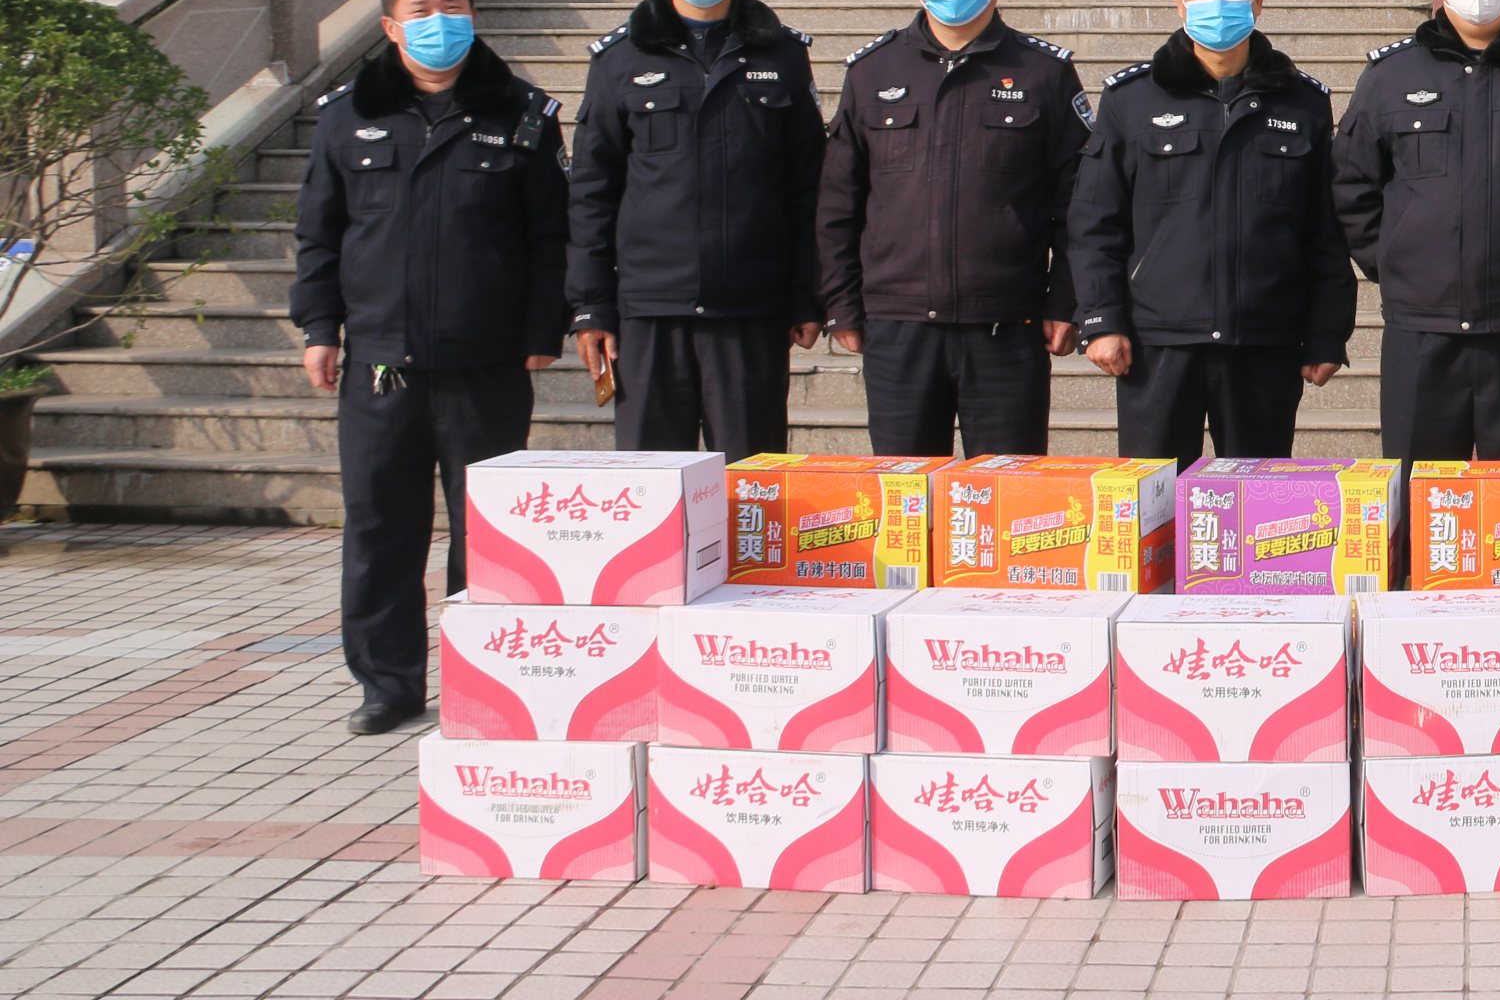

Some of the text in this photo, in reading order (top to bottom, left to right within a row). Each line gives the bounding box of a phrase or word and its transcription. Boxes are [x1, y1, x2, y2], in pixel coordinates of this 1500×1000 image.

[746, 71, 778, 80] 073609
[991, 89, 1024, 100] 175158
[1267, 118, 1297, 131] 175366
[510, 481, 642, 524] 娃哈哈
[886, 490, 903, 549] 箱箱送
[1098, 495, 1114, 556] 箱箱送
[1345, 498, 1362, 559] 箱箱送
[547, 529, 604, 542] 饮用纯净水
[737, 503, 764, 563] 劲爽
[767, 521, 782, 564] 拉面
[950, 506, 978, 567] 劲爽
[979, 524, 994, 568] 拉面
[1191, 511, 1220, 572] 劲爽
[1429, 511, 1458, 573] 劲爽
[1222, 529, 1237, 572] 拉面
[1461, 529, 1477, 573] 拉面
[796, 562, 867, 579] 香辣牛肉面
[1008, 565, 1077, 585] 香辣牛肉面
[1250, 570, 1328, 586] 老坛酸菜牛肉面
[483, 617, 617, 659] 娃哈哈
[693, 633, 833, 671] Wahaha
[923, 639, 1068, 675] Wahaha
[1162, 637, 1303, 681] 娃哈哈
[519, 665, 576, 678] 饮用纯净水
[730, 673, 799, 685] PURIFIED WATER
[962, 677, 1033, 688] PURIFIED WATER
[1441, 679, 1482, 689] PURIFIED
[734, 683, 795, 695] FOR DRINKING
[966, 688, 1029, 699] FOR DRINKING
[1202, 686, 1263, 698] 饮用纯净水
[1445, 689, 1462, 699] FOR
[454, 765, 593, 801] Wahaha
[689, 764, 821, 808] 娃哈哈
[914, 771, 1049, 814] 娃哈哈
[1157, 788, 1306, 820] Wahaha
[496, 814, 555, 824] FOR DRINKING
[725, 812, 783, 825] 饮用纯净水
[952, 820, 1010, 833] 饮用纯净水
[1199, 824, 1272, 834] PURIFIED WATER
[1204, 835, 1267, 845] FOR DRINKING
